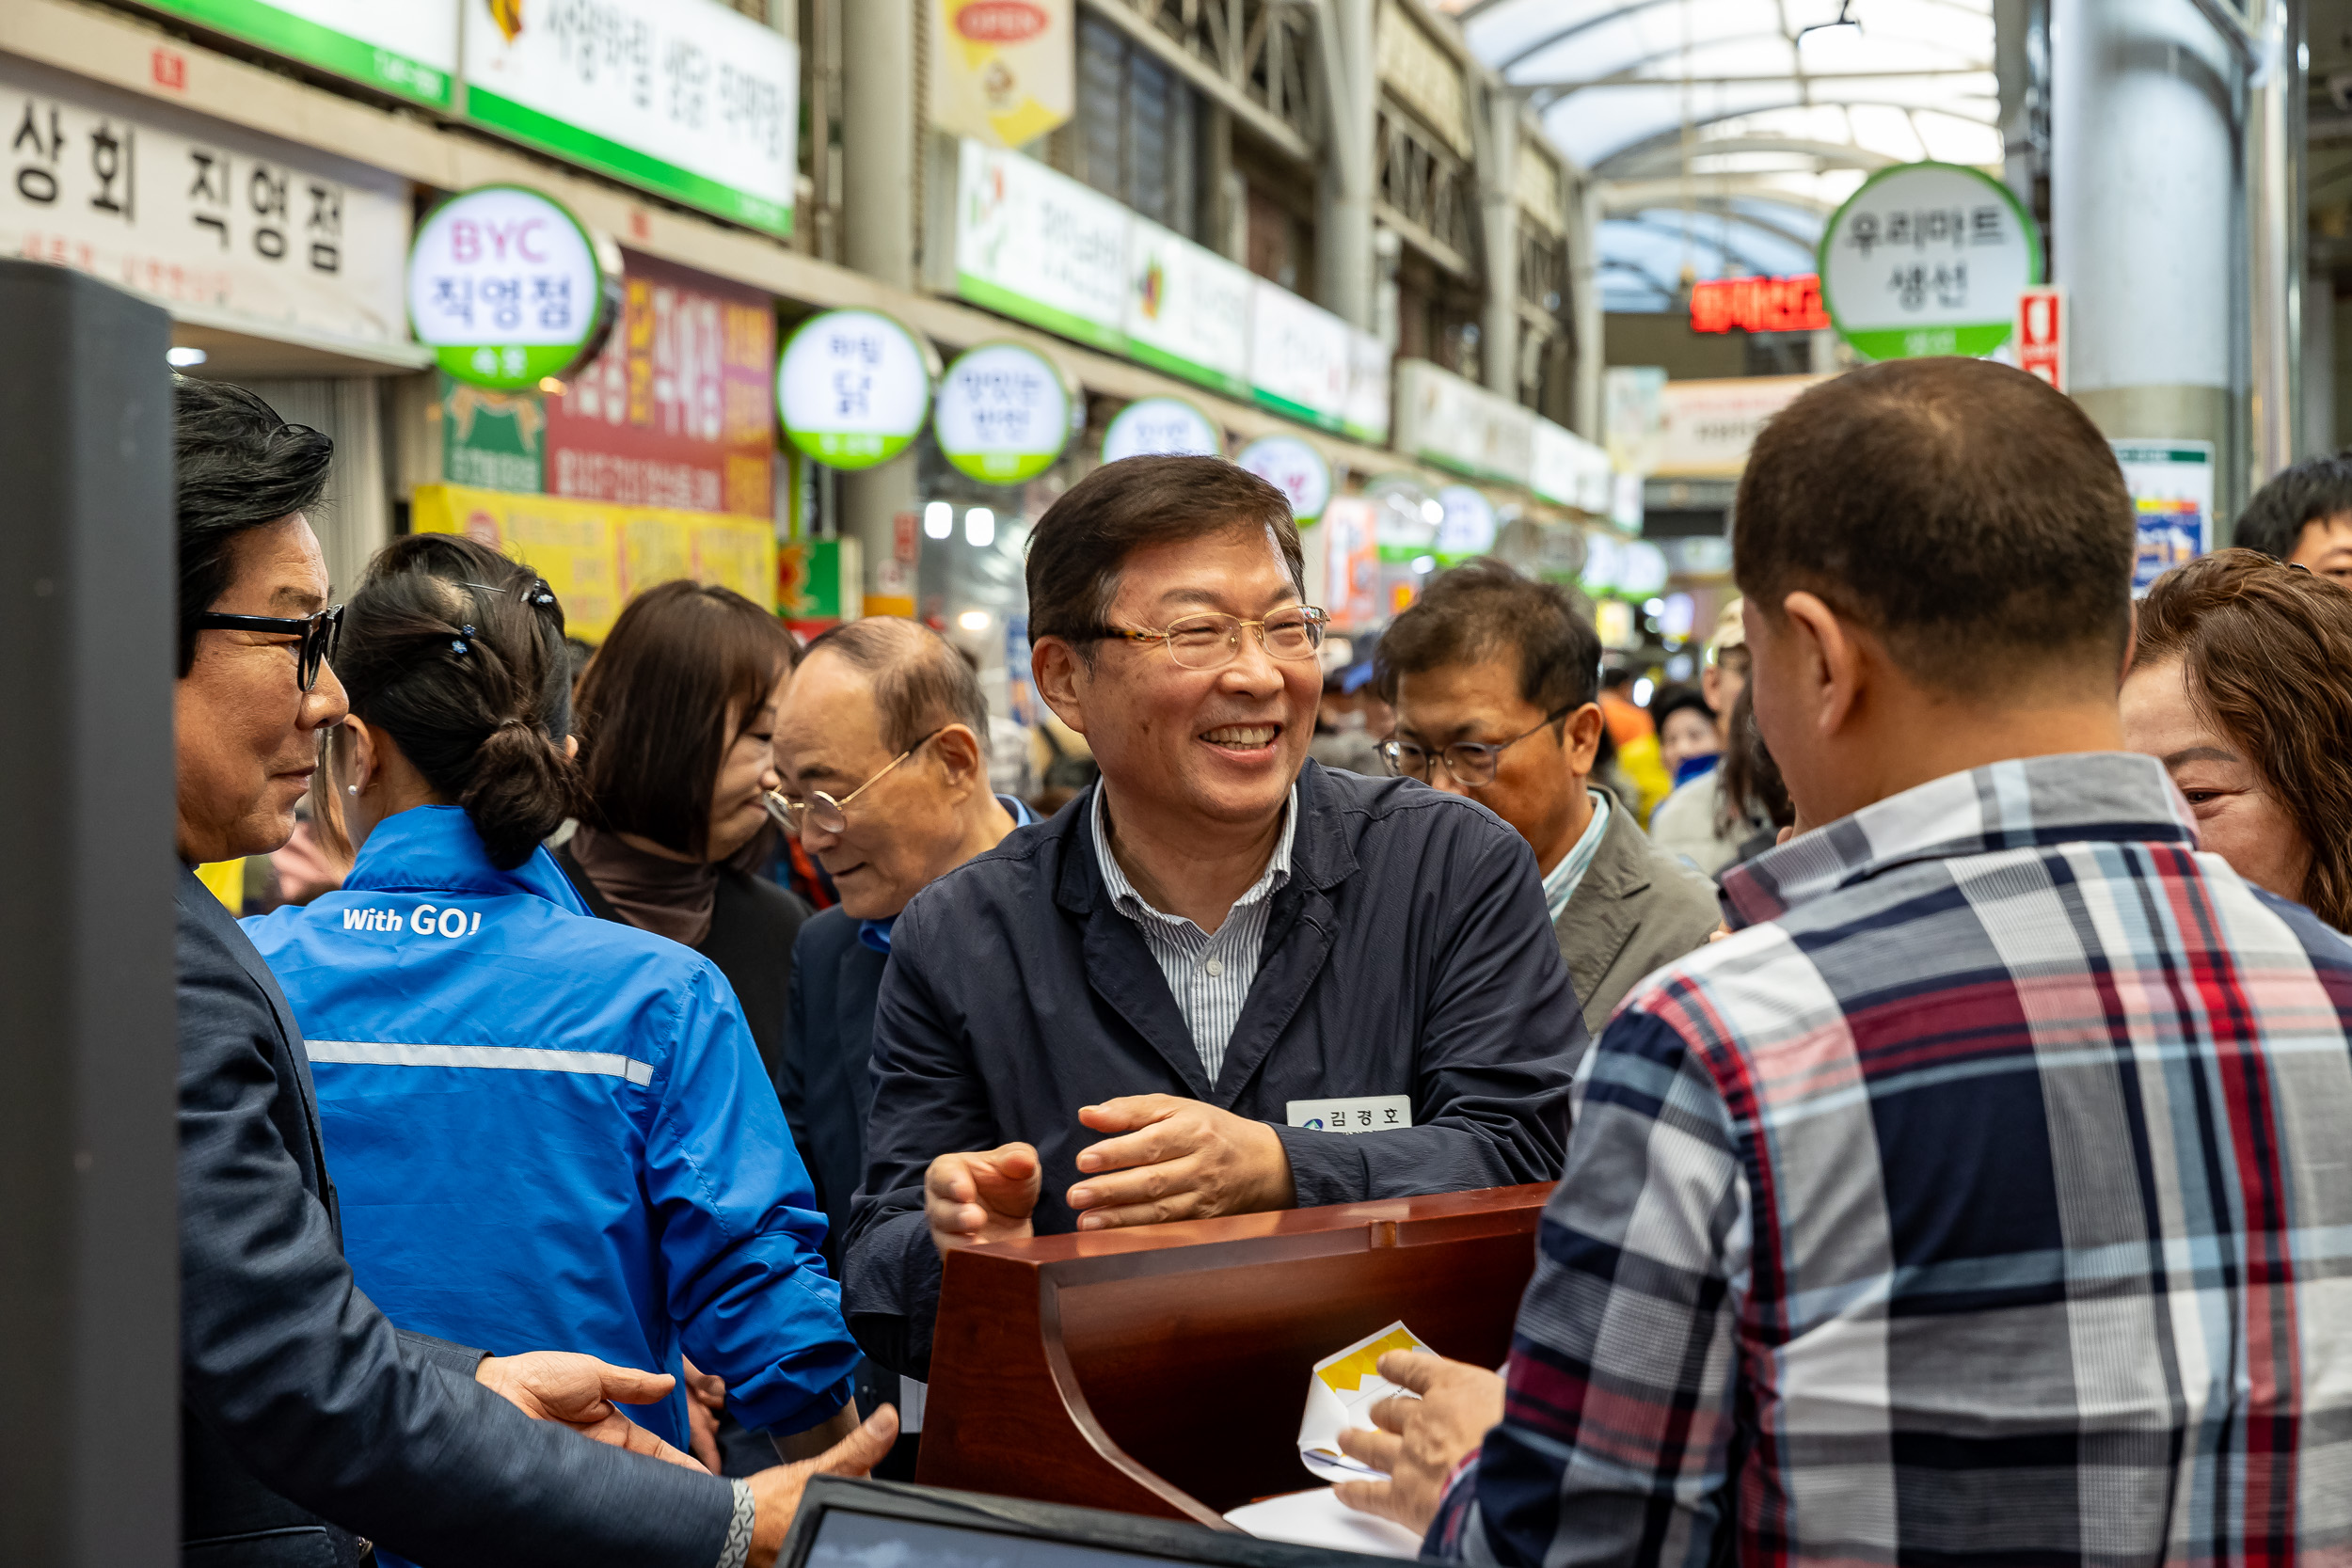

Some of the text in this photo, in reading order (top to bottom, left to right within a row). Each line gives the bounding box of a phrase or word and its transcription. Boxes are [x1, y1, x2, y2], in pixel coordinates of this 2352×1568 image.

[13, 97, 135, 223] 상회
[189, 148, 345, 275] 직영점
[451, 218, 548, 264] BYC
[1845, 205, 2008, 258] 우리마트
[430, 274, 572, 331] 직영점
[1887, 260, 1969, 312] 생선
[342, 904, 482, 939] With GO!
[1329, 1107, 1400, 1127] 김경호
